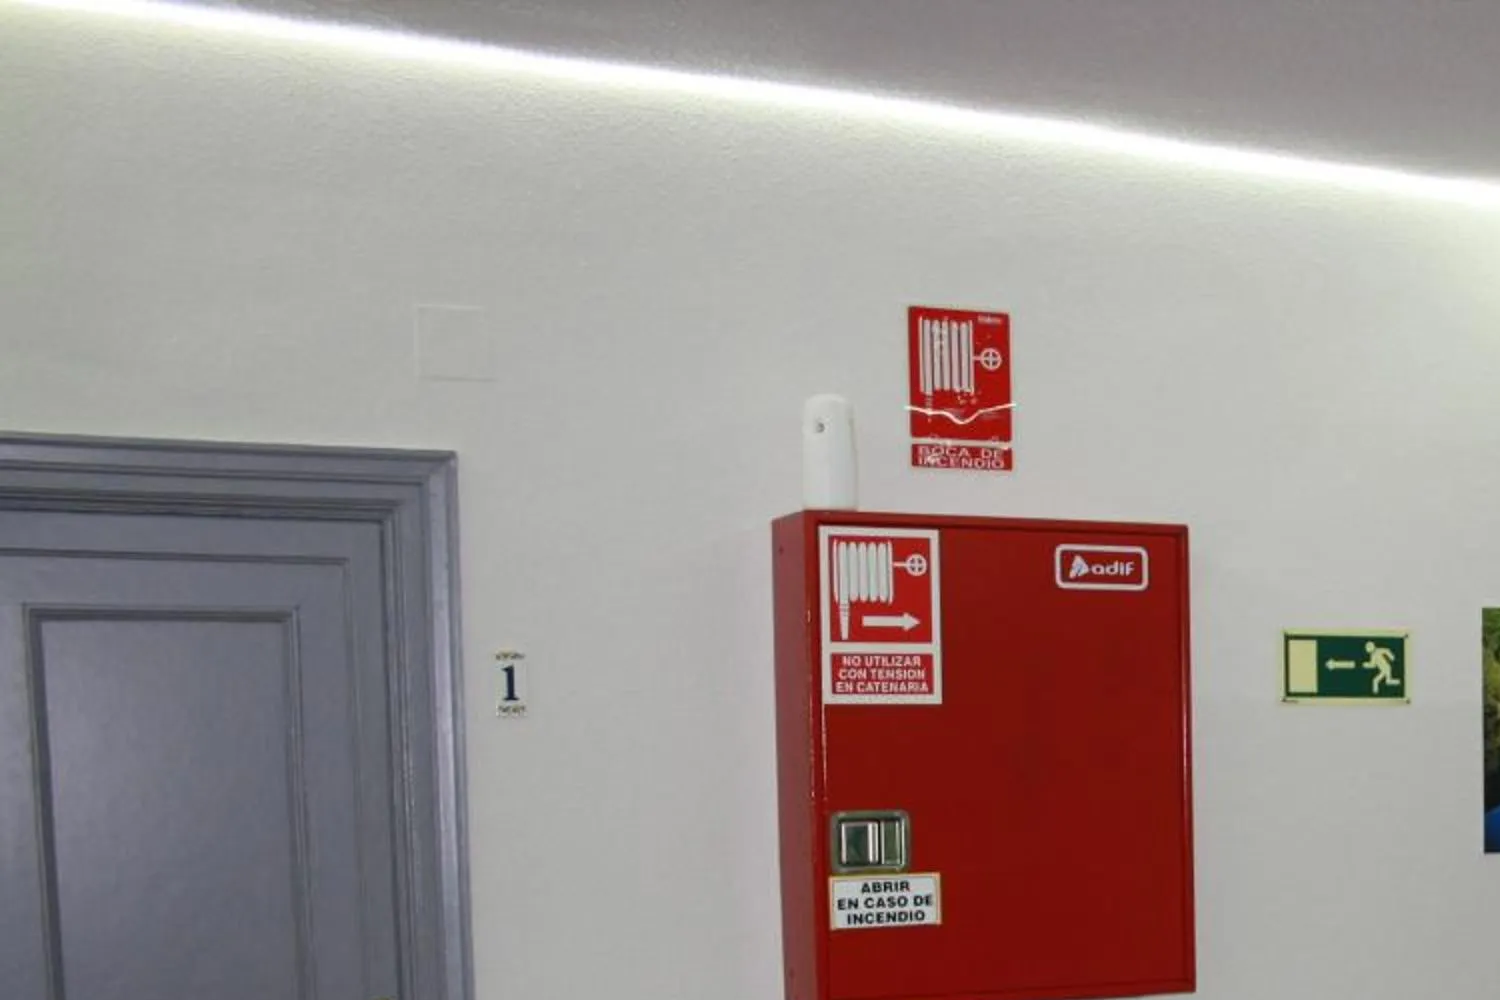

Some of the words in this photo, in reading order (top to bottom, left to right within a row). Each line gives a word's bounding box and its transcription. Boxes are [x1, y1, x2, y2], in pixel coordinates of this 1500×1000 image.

[1091, 560, 1135, 576] adif
[842, 655, 861, 666] NO
[865, 655, 922, 667] UTILIZAR
[838, 668, 867, 680] CON
[870, 668, 925, 680] TENSION
[501, 663, 520, 701] 1
[835, 681, 853, 693] EN
[856, 681, 929, 693] CATENARIA
[861, 880, 911, 894] ABRIR
[837, 897, 859, 911] EN
[863, 895, 909, 909] CASO
[913, 894, 934, 907] DE
[846, 909, 926, 925] INCENDIO
